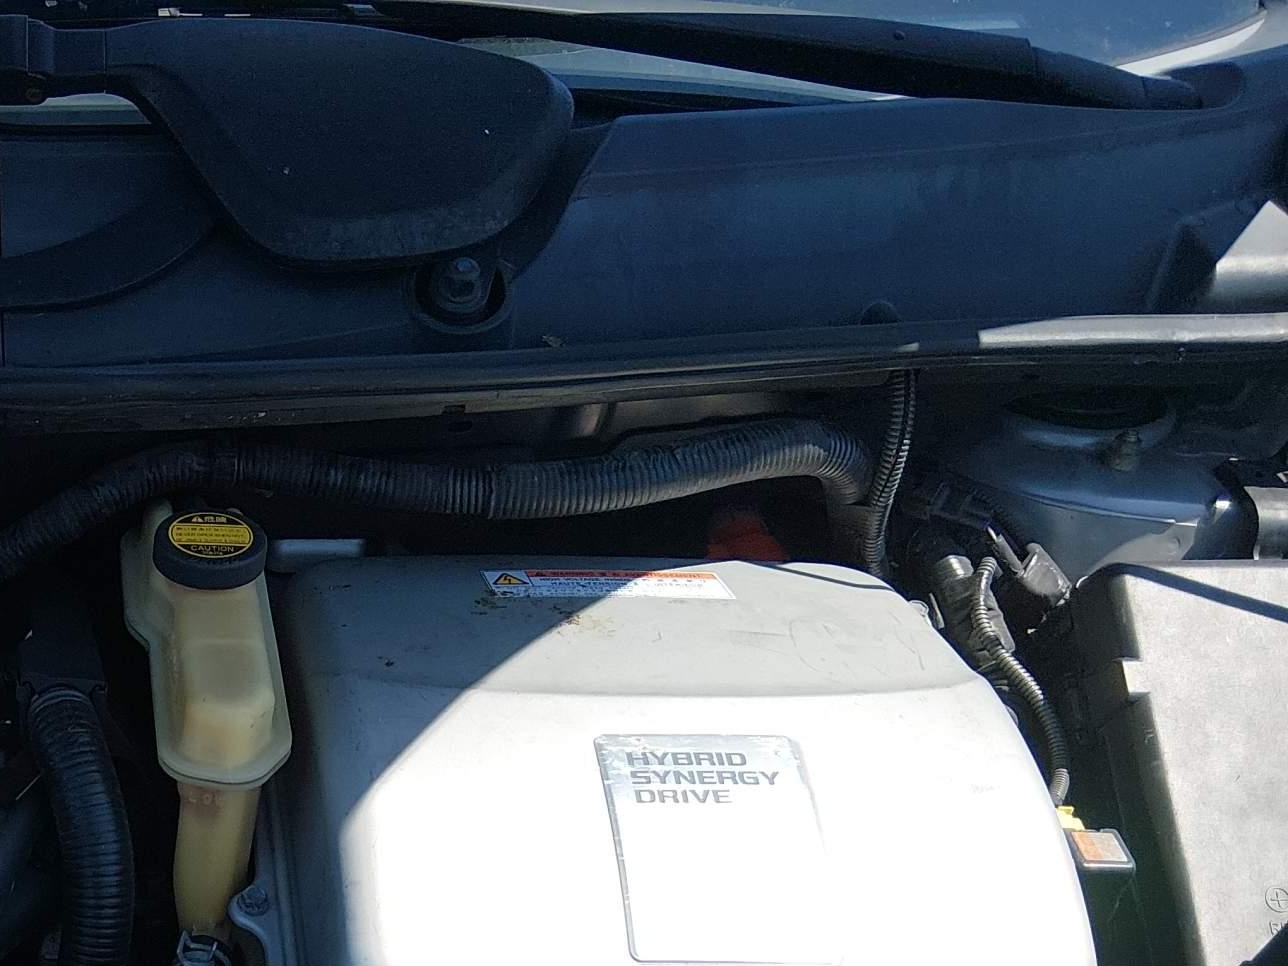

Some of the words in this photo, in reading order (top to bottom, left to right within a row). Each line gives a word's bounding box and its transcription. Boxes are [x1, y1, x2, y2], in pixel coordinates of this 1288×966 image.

[624, 751, 747, 766] HYBRID
[630, 770, 779, 785] SYNERGY
[634, 789, 734, 804] DRIVE
